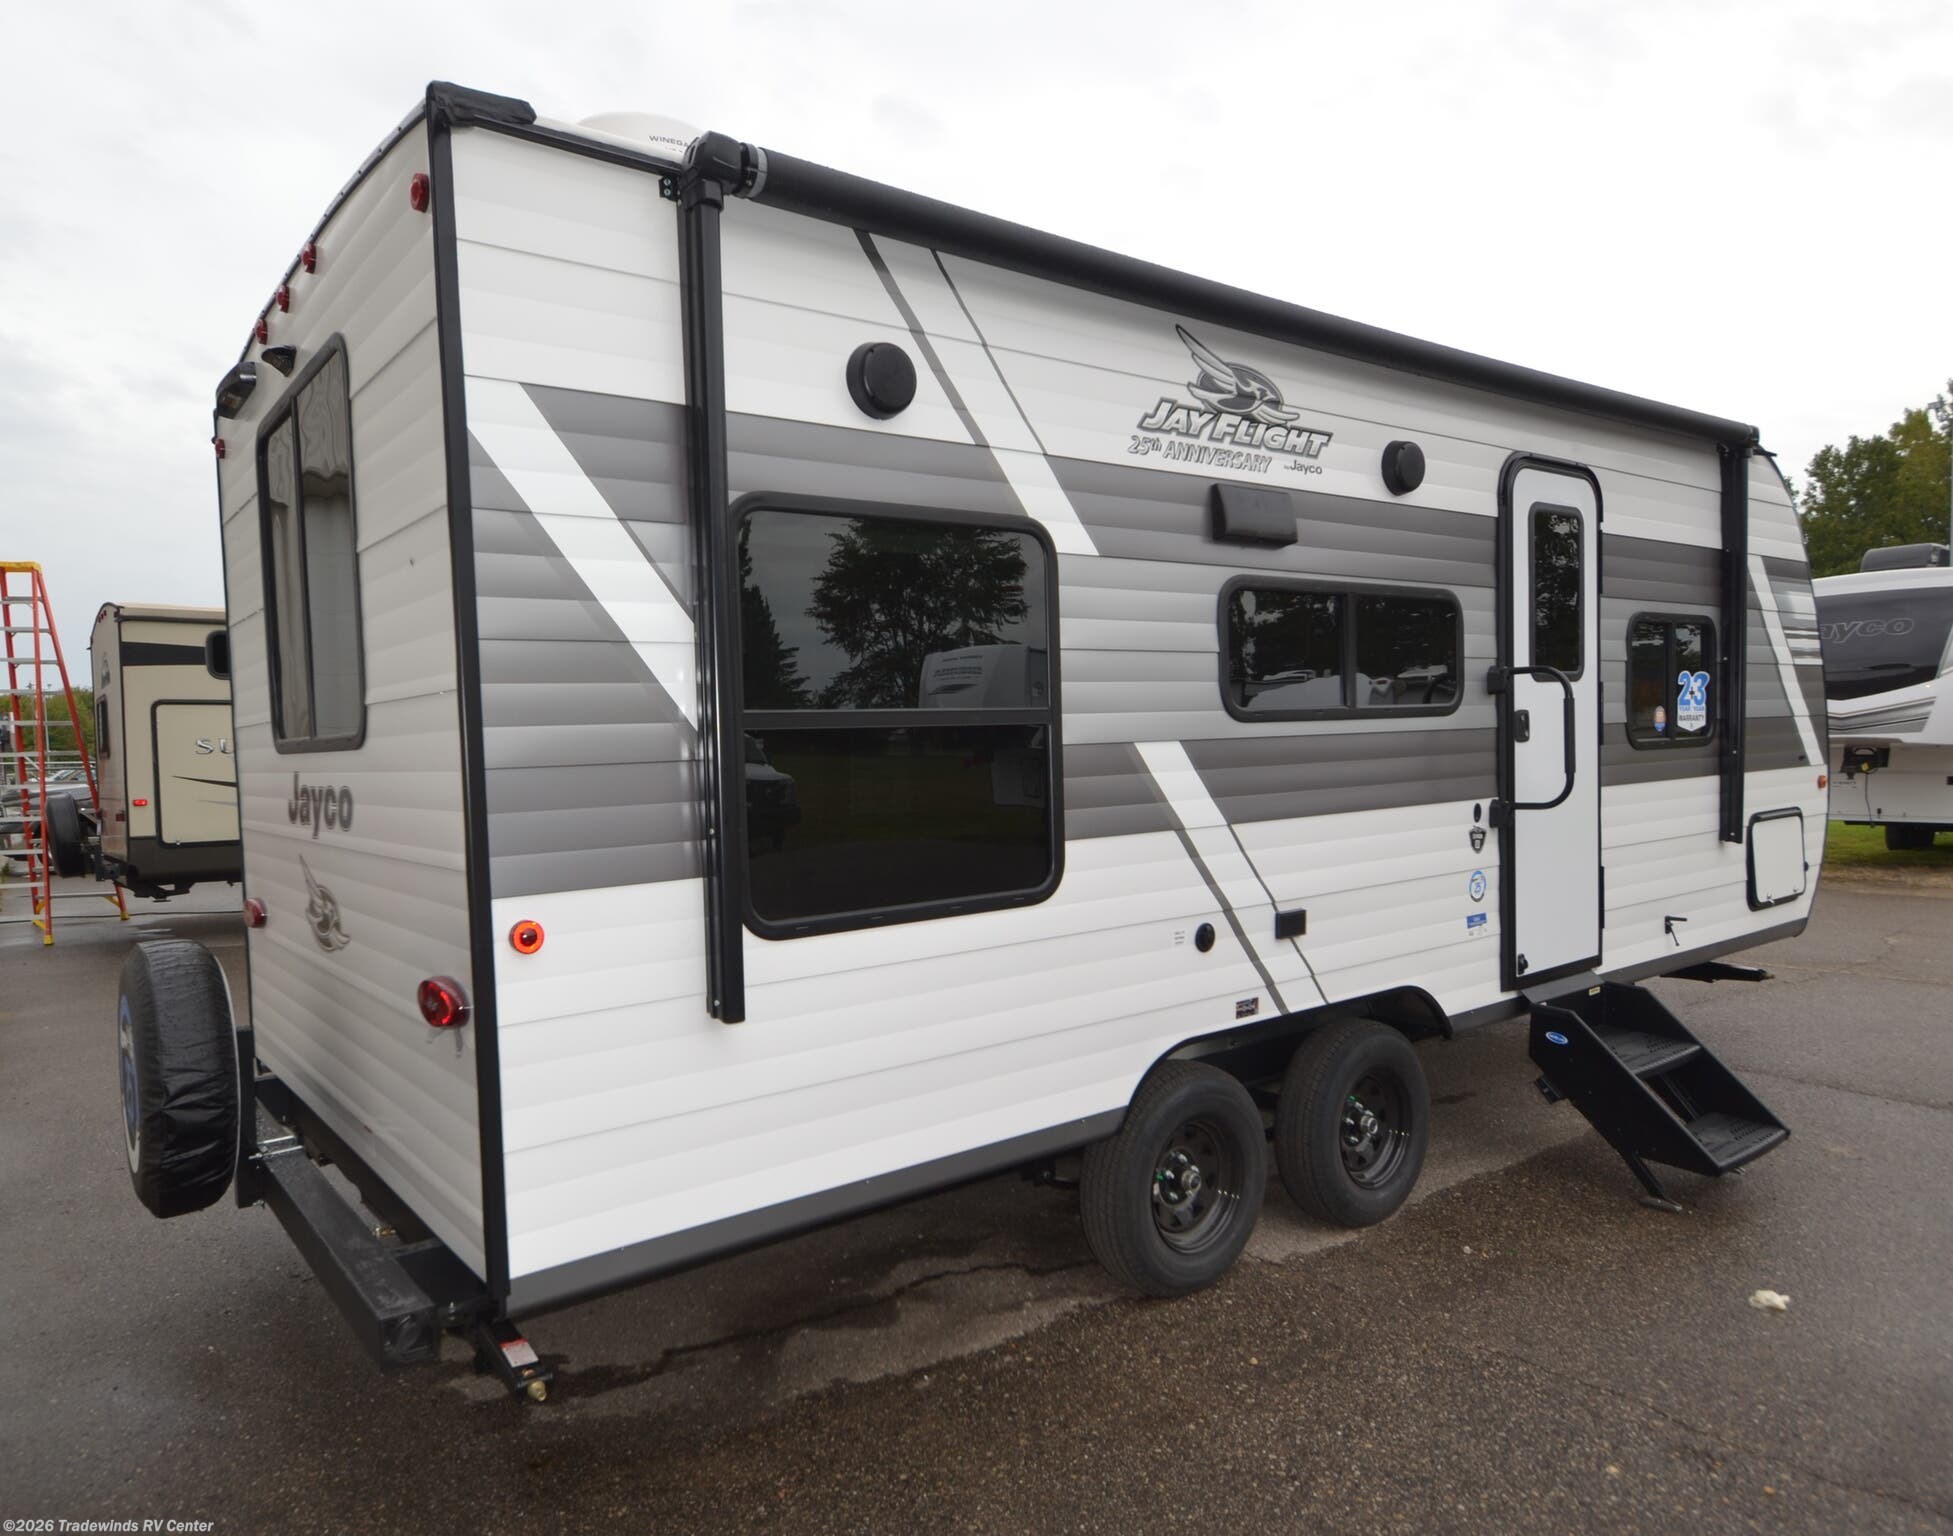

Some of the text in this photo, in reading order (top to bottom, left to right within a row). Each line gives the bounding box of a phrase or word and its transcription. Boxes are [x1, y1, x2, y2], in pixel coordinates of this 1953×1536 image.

[1127, 434, 1273, 474] 25th ANNIVERSARY
[1290, 459, 1323, 475] Jayco
[288, 771, 354, 840] Jayco
